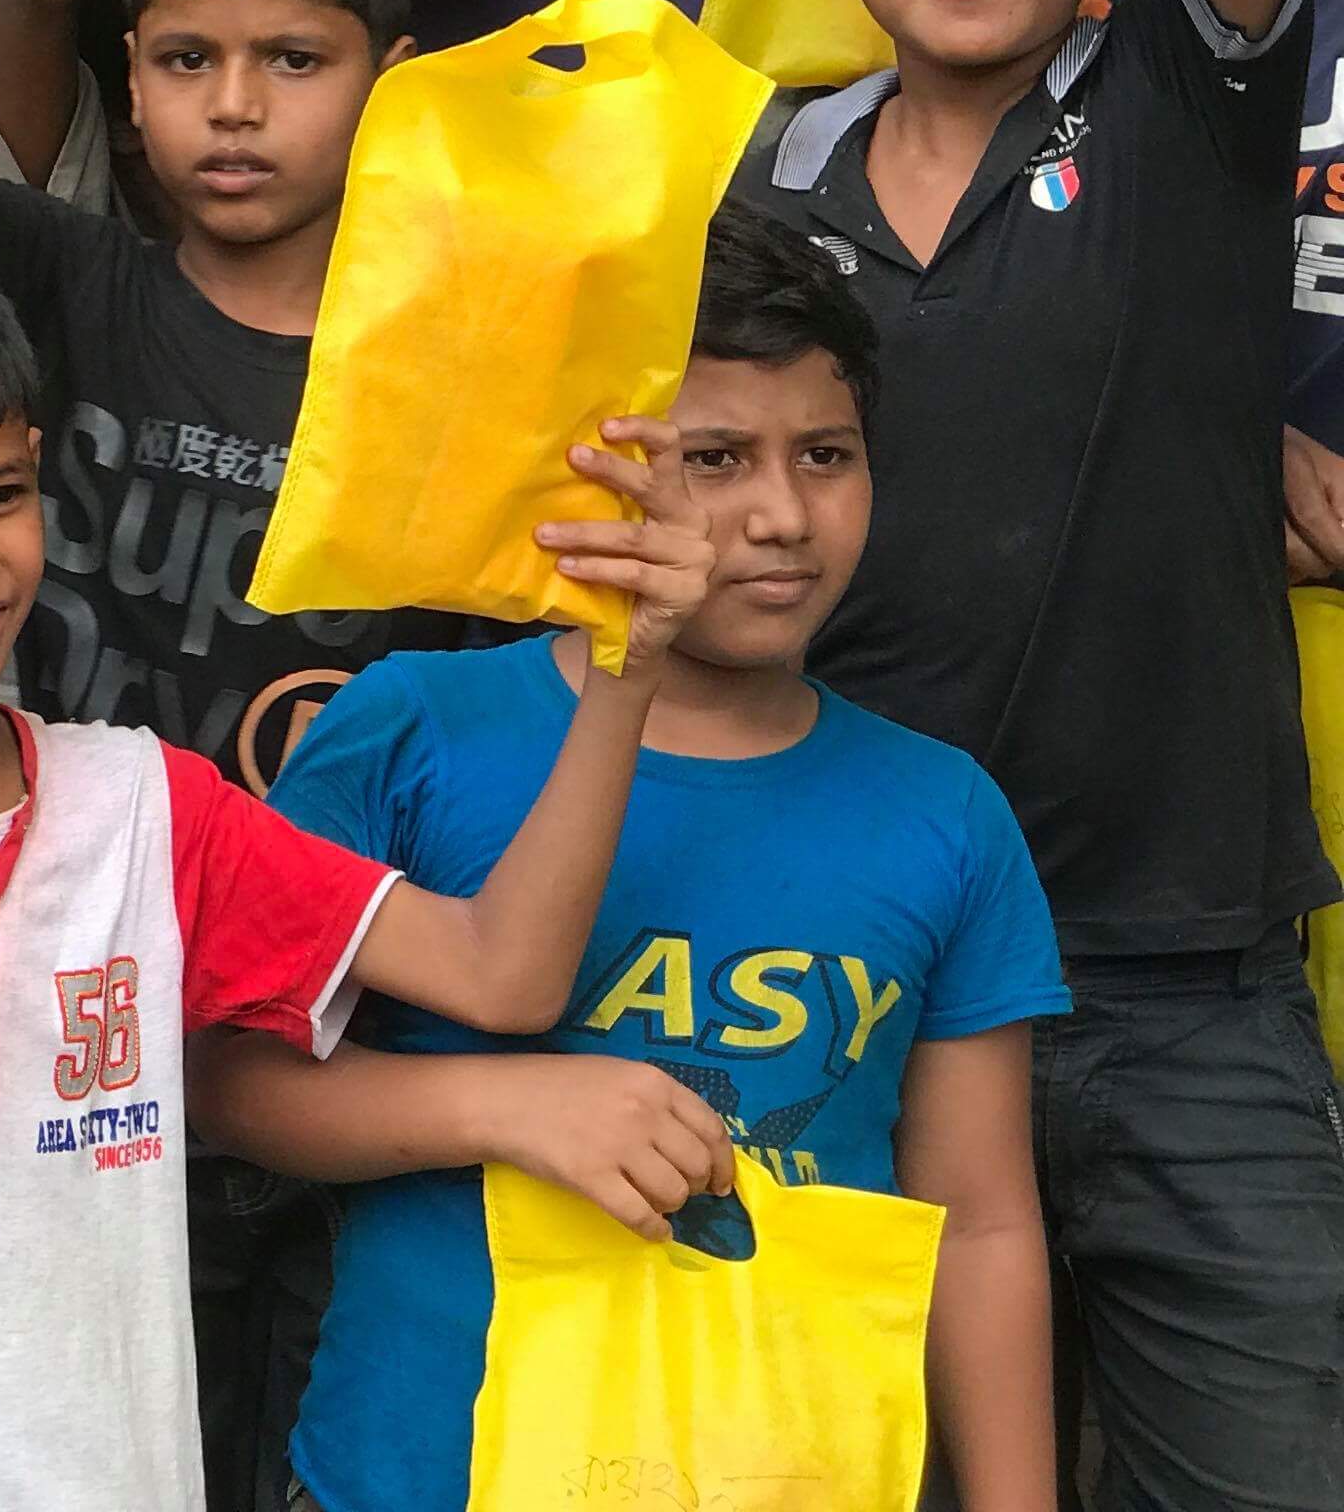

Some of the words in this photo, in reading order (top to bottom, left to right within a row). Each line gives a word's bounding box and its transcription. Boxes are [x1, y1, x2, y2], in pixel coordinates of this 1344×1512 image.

[53, 954, 142, 1101] 56
[36, 1117, 77, 1154] AREA
[78, 1100, 160, 1150] SXTY-TWO
